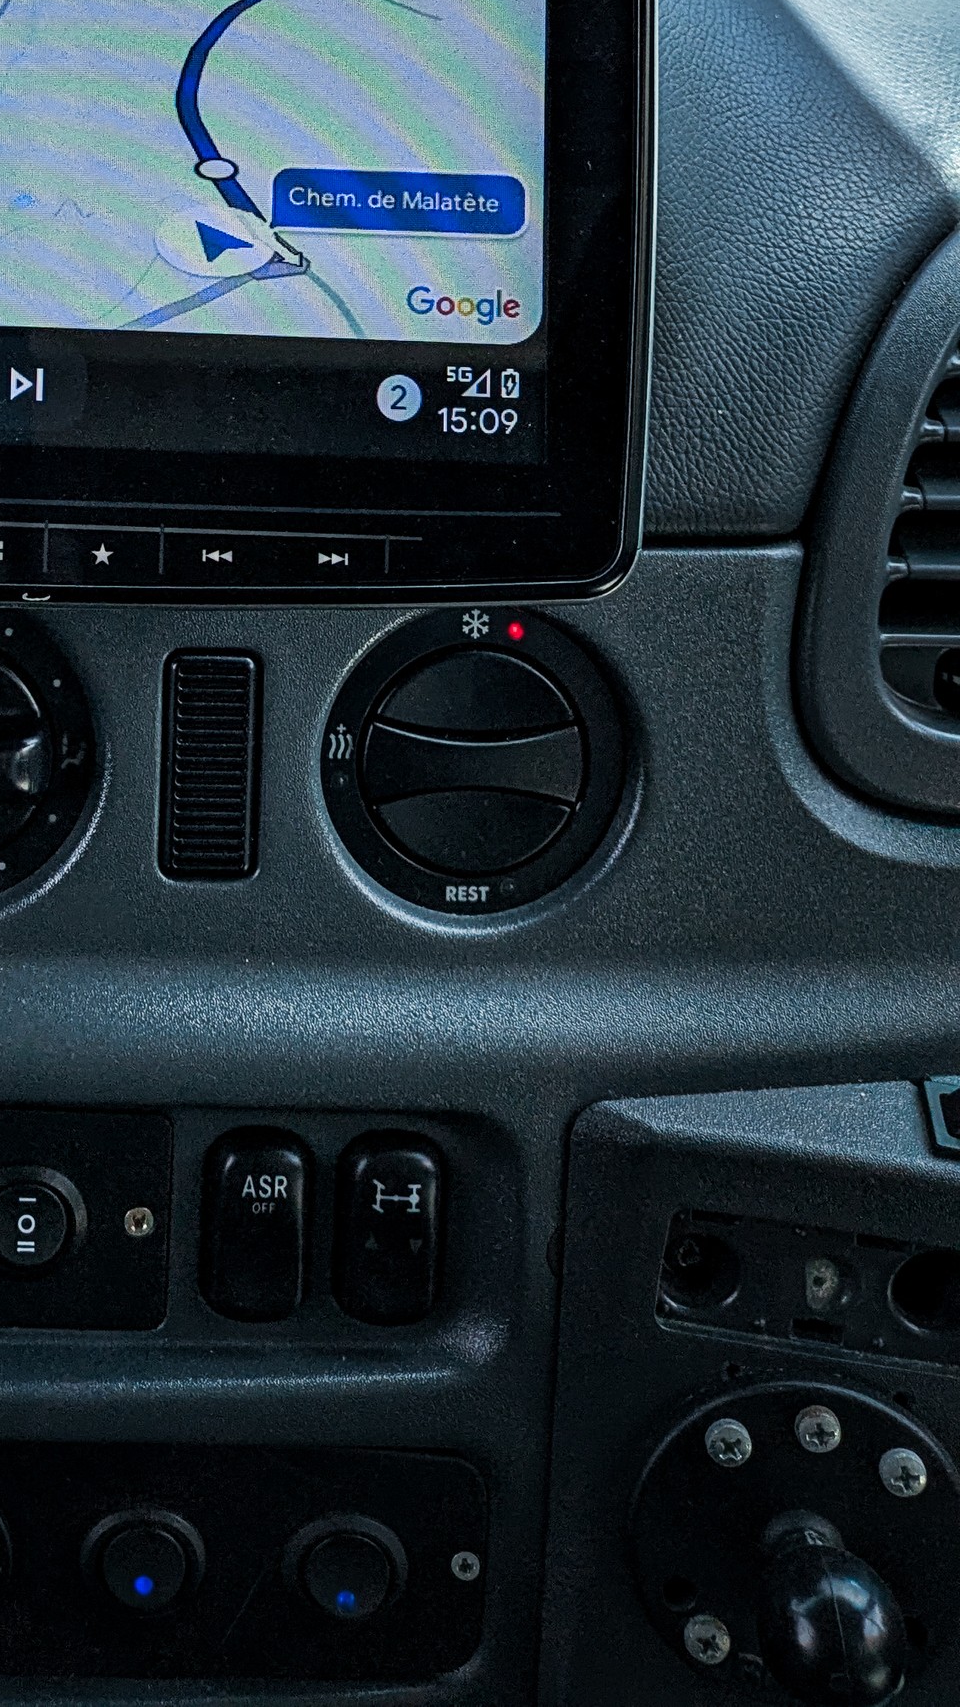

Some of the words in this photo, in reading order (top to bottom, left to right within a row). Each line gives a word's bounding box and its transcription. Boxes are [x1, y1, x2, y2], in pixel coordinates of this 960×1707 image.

[288, 186, 361, 208] Chem.
[368, 191, 395, 209] de
[402, 191, 500, 213] Malatête
[407, 286, 520, 325] Google
[446, 366, 473, 383] 5G
[389, 385, 407, 410] 2
[438, 407, 519, 434] 15:09
[445, 886, 490, 902] REST
[241, 1174, 288, 1199] ASR
[252, 1202, 276, 1215] OFF
